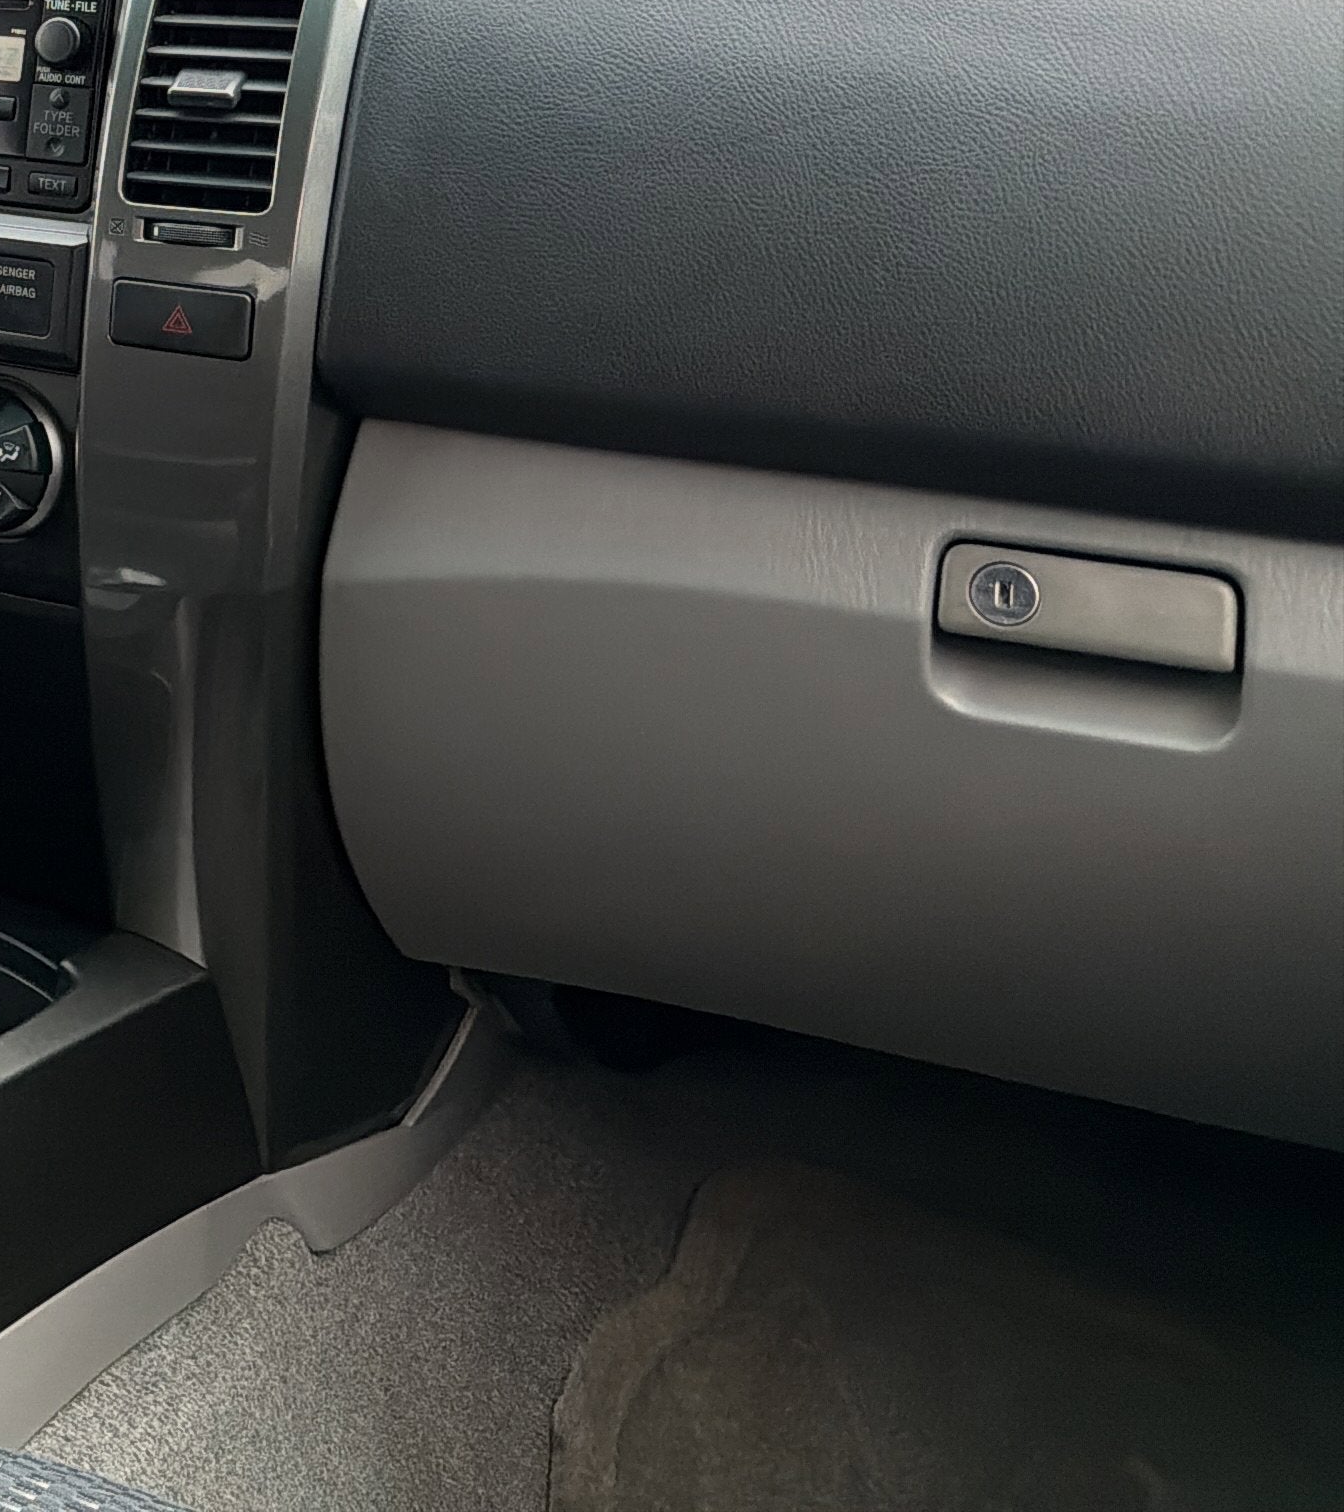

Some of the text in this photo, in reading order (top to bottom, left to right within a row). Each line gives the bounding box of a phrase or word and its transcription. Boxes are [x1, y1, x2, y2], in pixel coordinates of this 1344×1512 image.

[38, 73, 86, 86] AUDIO CONT
[43, 110, 73, 123] TYPE
[33, 122, 80, 137] FOLDER
[38, 177, 67, 191] TEXT
[0, 284, 36, 299] AIRBAG
